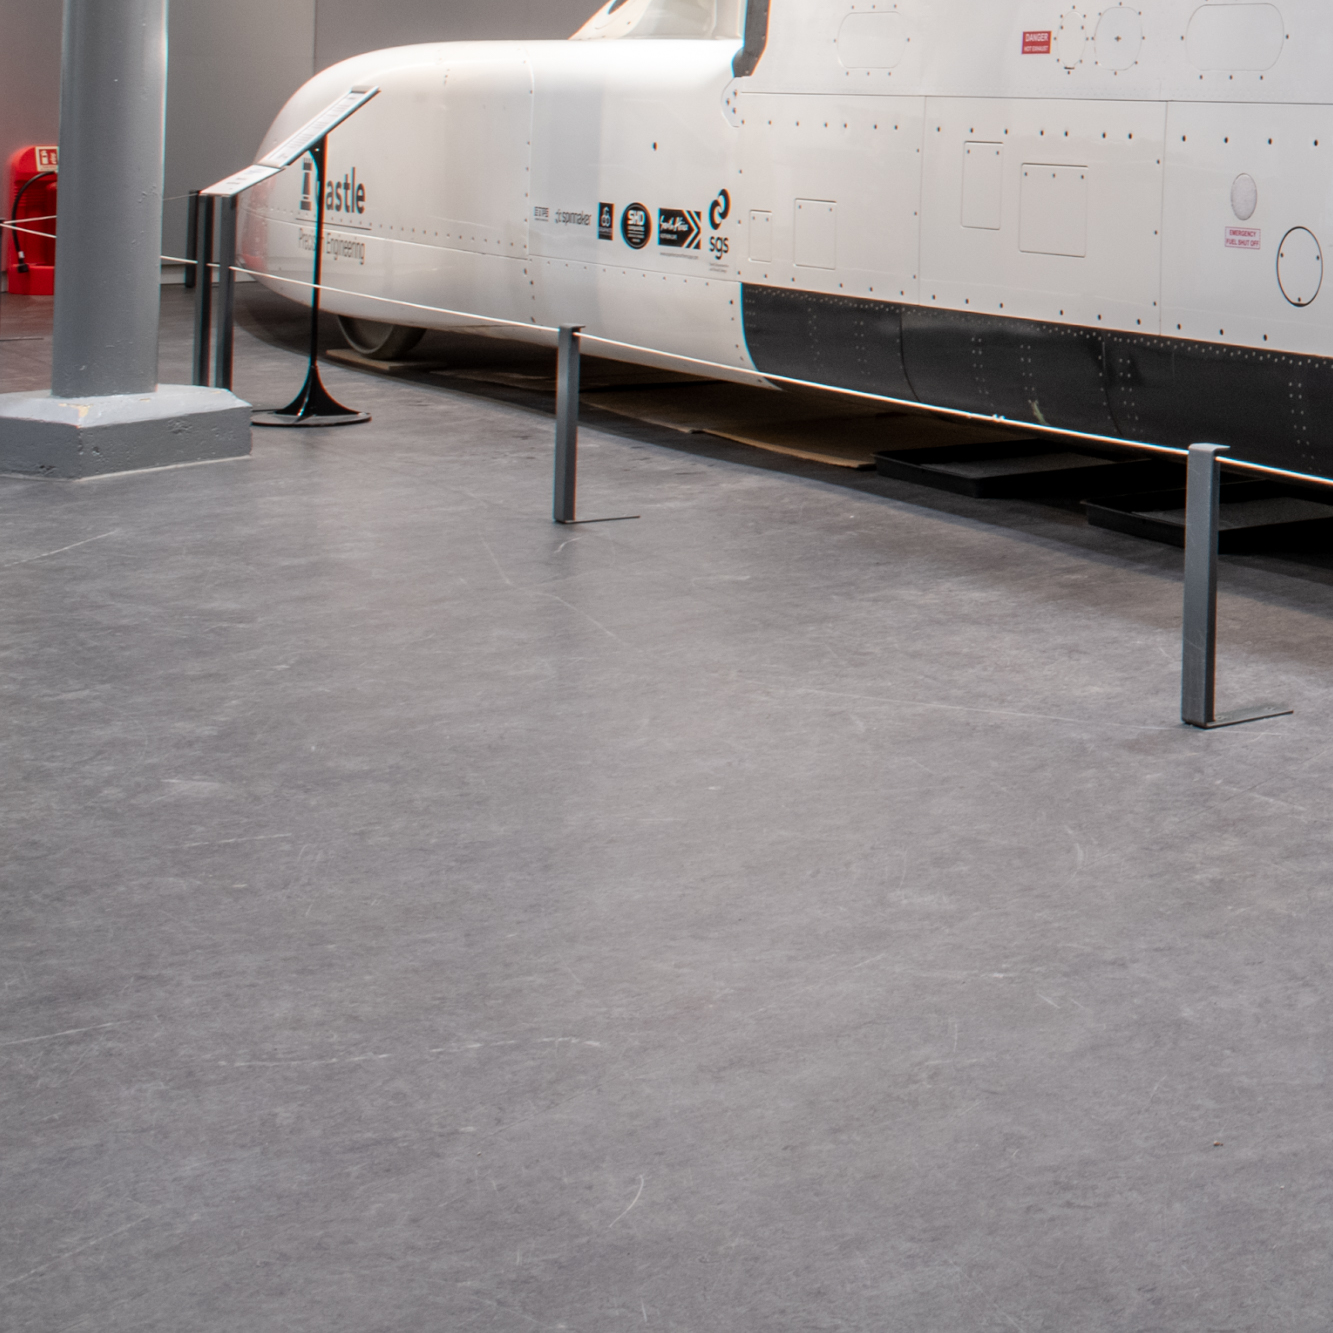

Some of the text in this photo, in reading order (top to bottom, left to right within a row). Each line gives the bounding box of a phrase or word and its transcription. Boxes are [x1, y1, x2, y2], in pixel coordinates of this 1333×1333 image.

[1025, 33, 1049, 42] DANGER
[315, 166, 366, 214] astle
[627, 209, 646, 226] SHD
[1229, 229, 1257, 237] EMERGENCY
[708, 235, 730, 260] sgs
